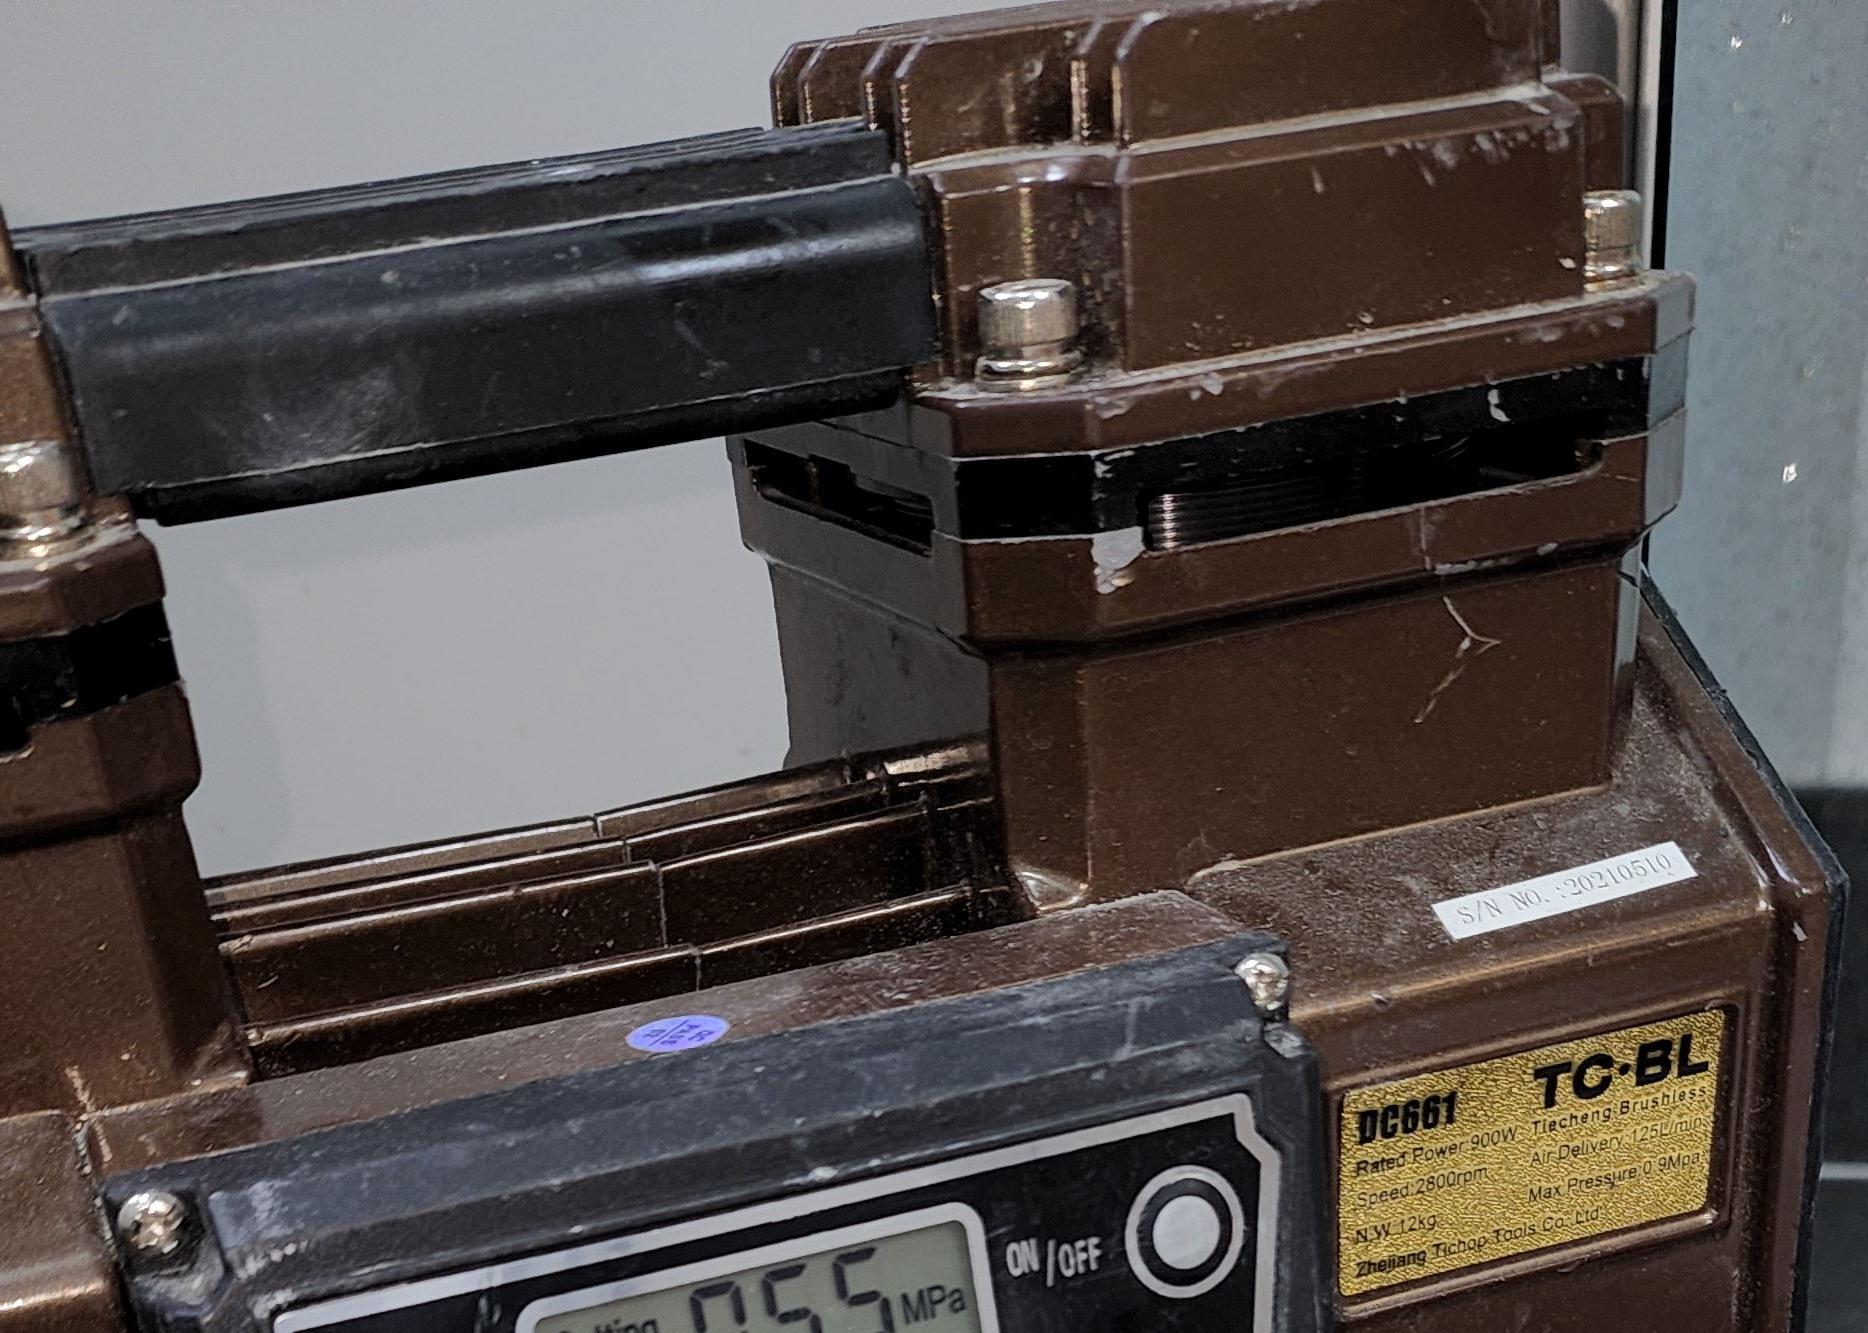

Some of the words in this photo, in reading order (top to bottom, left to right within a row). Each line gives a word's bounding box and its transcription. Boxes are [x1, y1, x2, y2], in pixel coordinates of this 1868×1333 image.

[1456, 898, 1504, 925] S/N
[1357, 1090, 1458, 1146] DC661
[1532, 1107, 1612, 1136] Tiecheng
[1619, 1085, 1706, 1116] Brushless
[1355, 1153, 1407, 1177] Rated
[1530, 1150, 1553, 1167] Air
[1528, 1183, 1562, 1202] Max
[1355, 1250, 1427, 1278] Zhejiang
[1493, 1223, 1536, 1247] Tools
[901, 1283, 968, 1326] MPa
